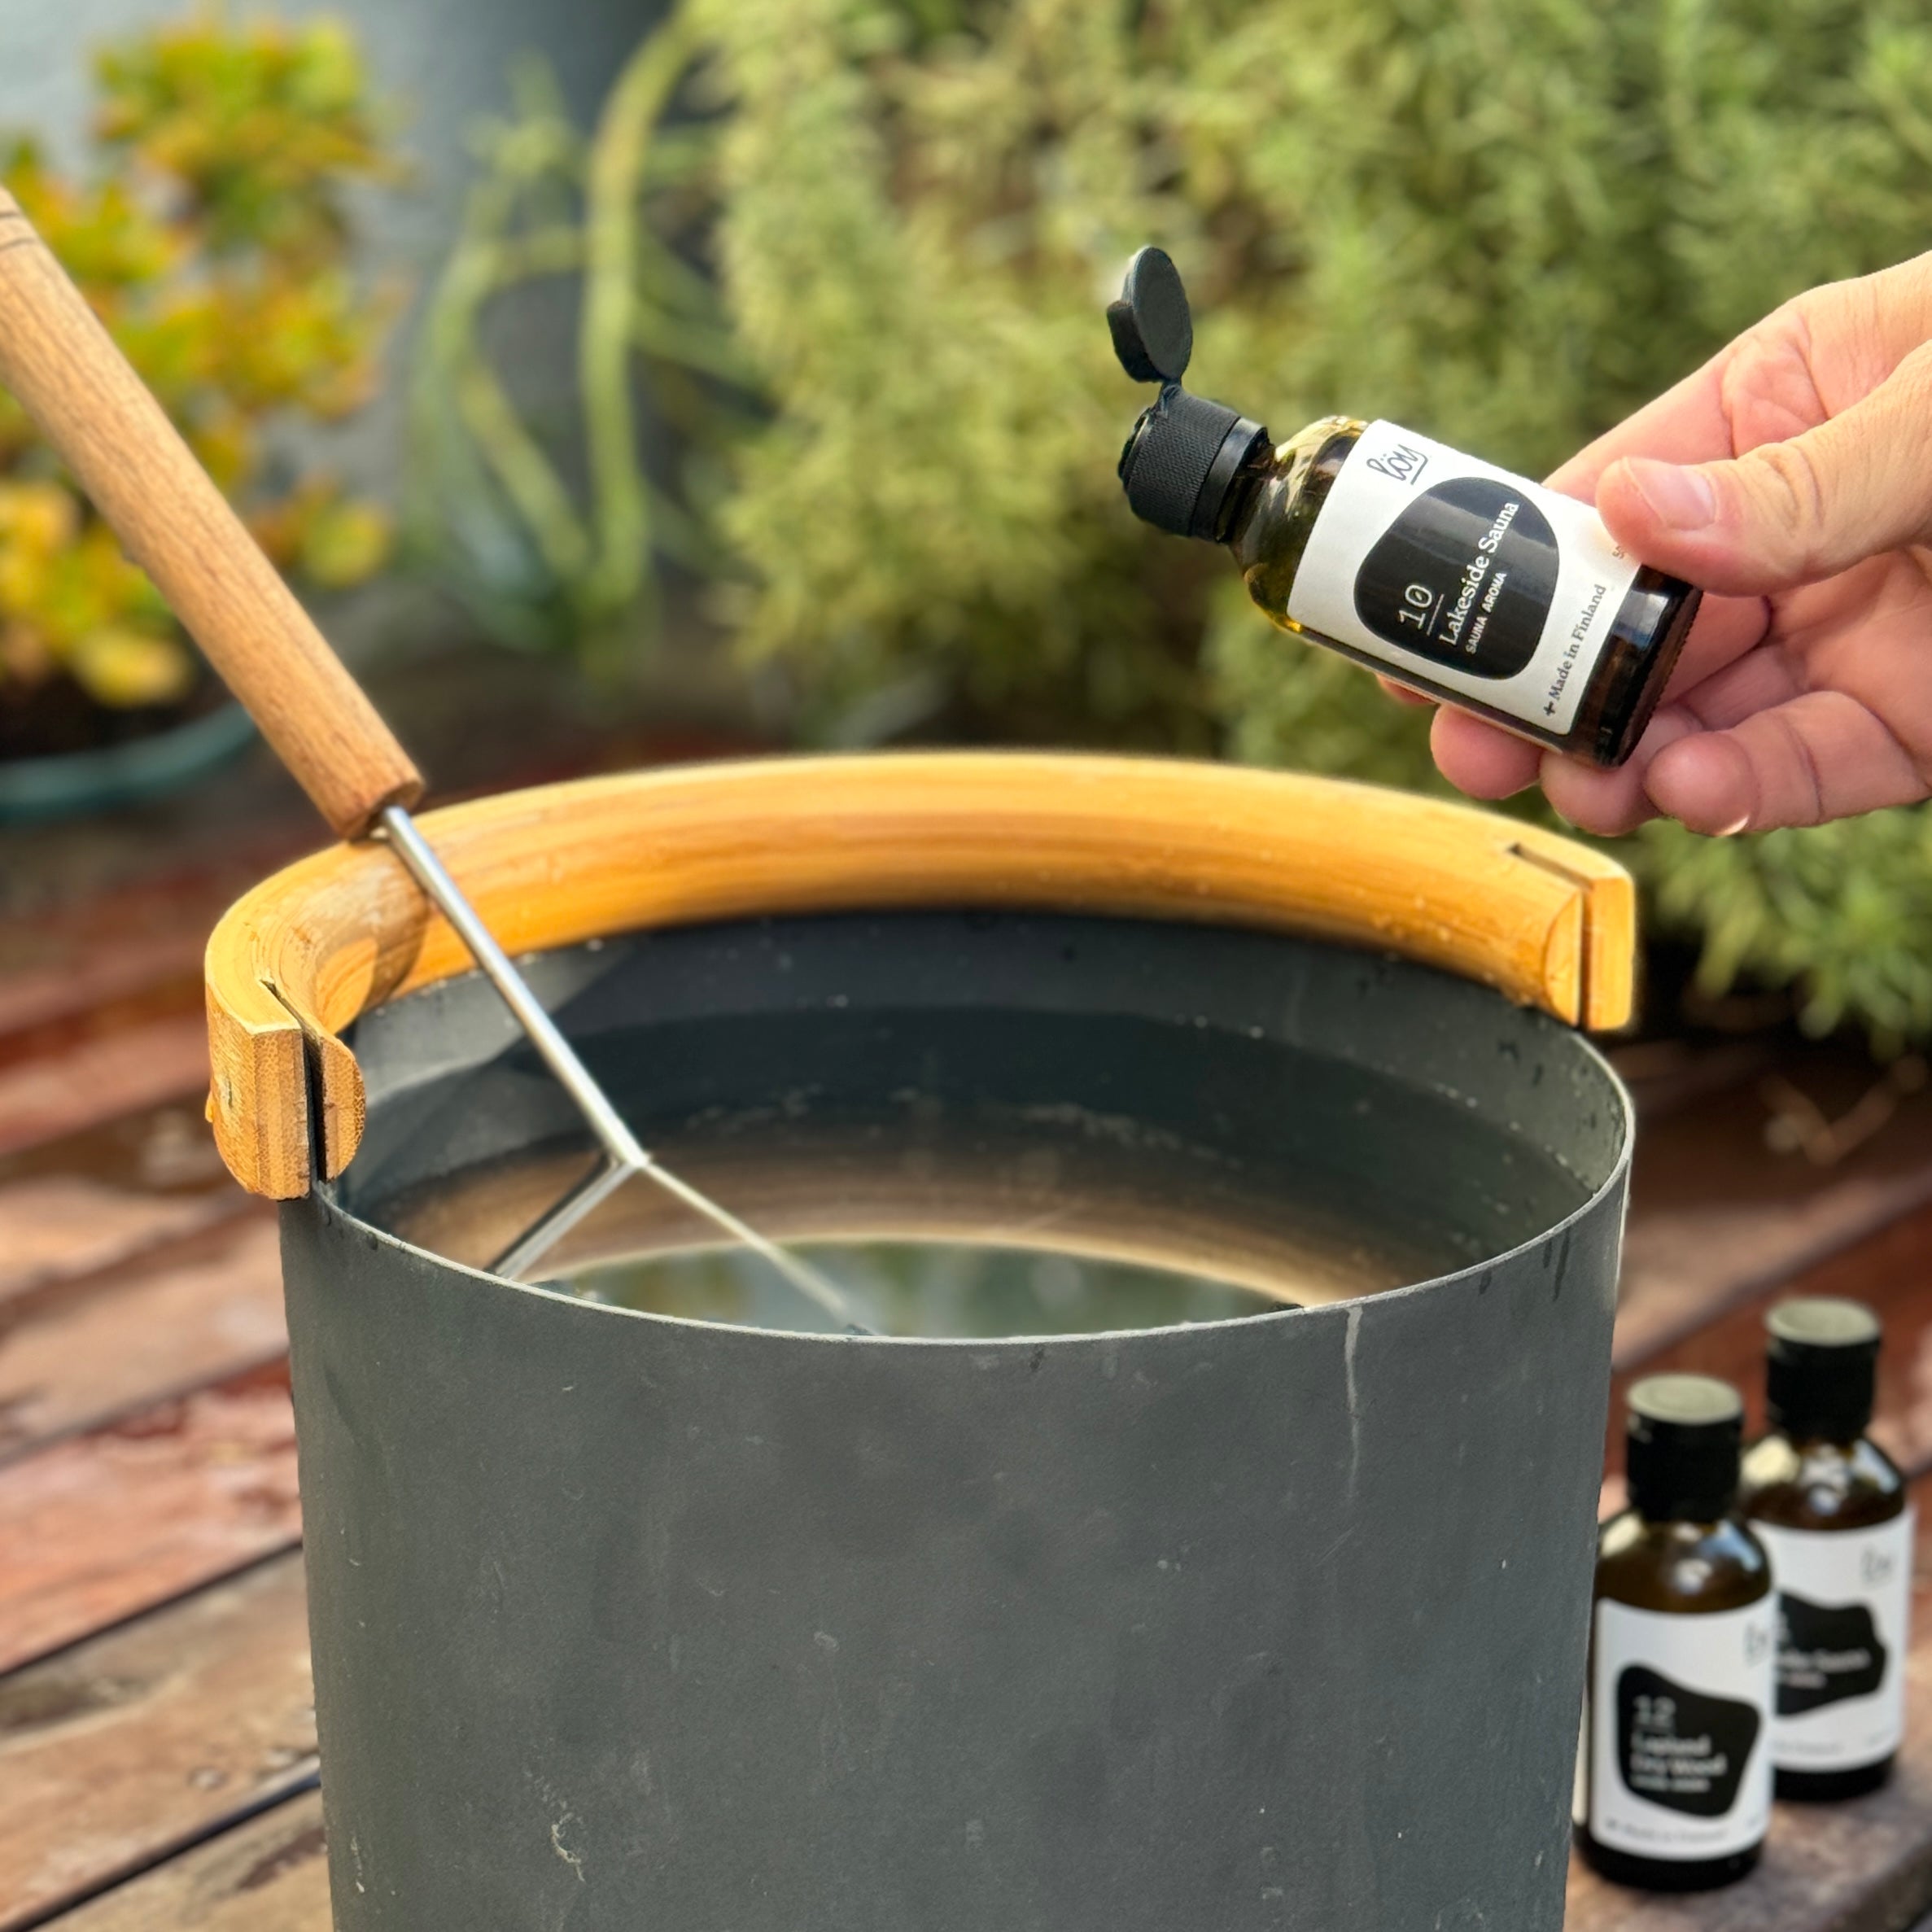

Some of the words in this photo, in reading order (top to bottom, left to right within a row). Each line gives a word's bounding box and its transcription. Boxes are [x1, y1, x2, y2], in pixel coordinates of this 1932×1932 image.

[1439, 556, 1489, 645] Lakeside
[1478, 502, 1519, 553] Sauna
[1398, 584, 1432, 630] 10
[1465, 616, 1488, 654] SAUNA
[1481, 571, 1507, 613] AROMA
[1571, 584, 1606, 642] Finland
[1564, 644, 1580, 661] in
[1548, 660, 1572, 701] Made
